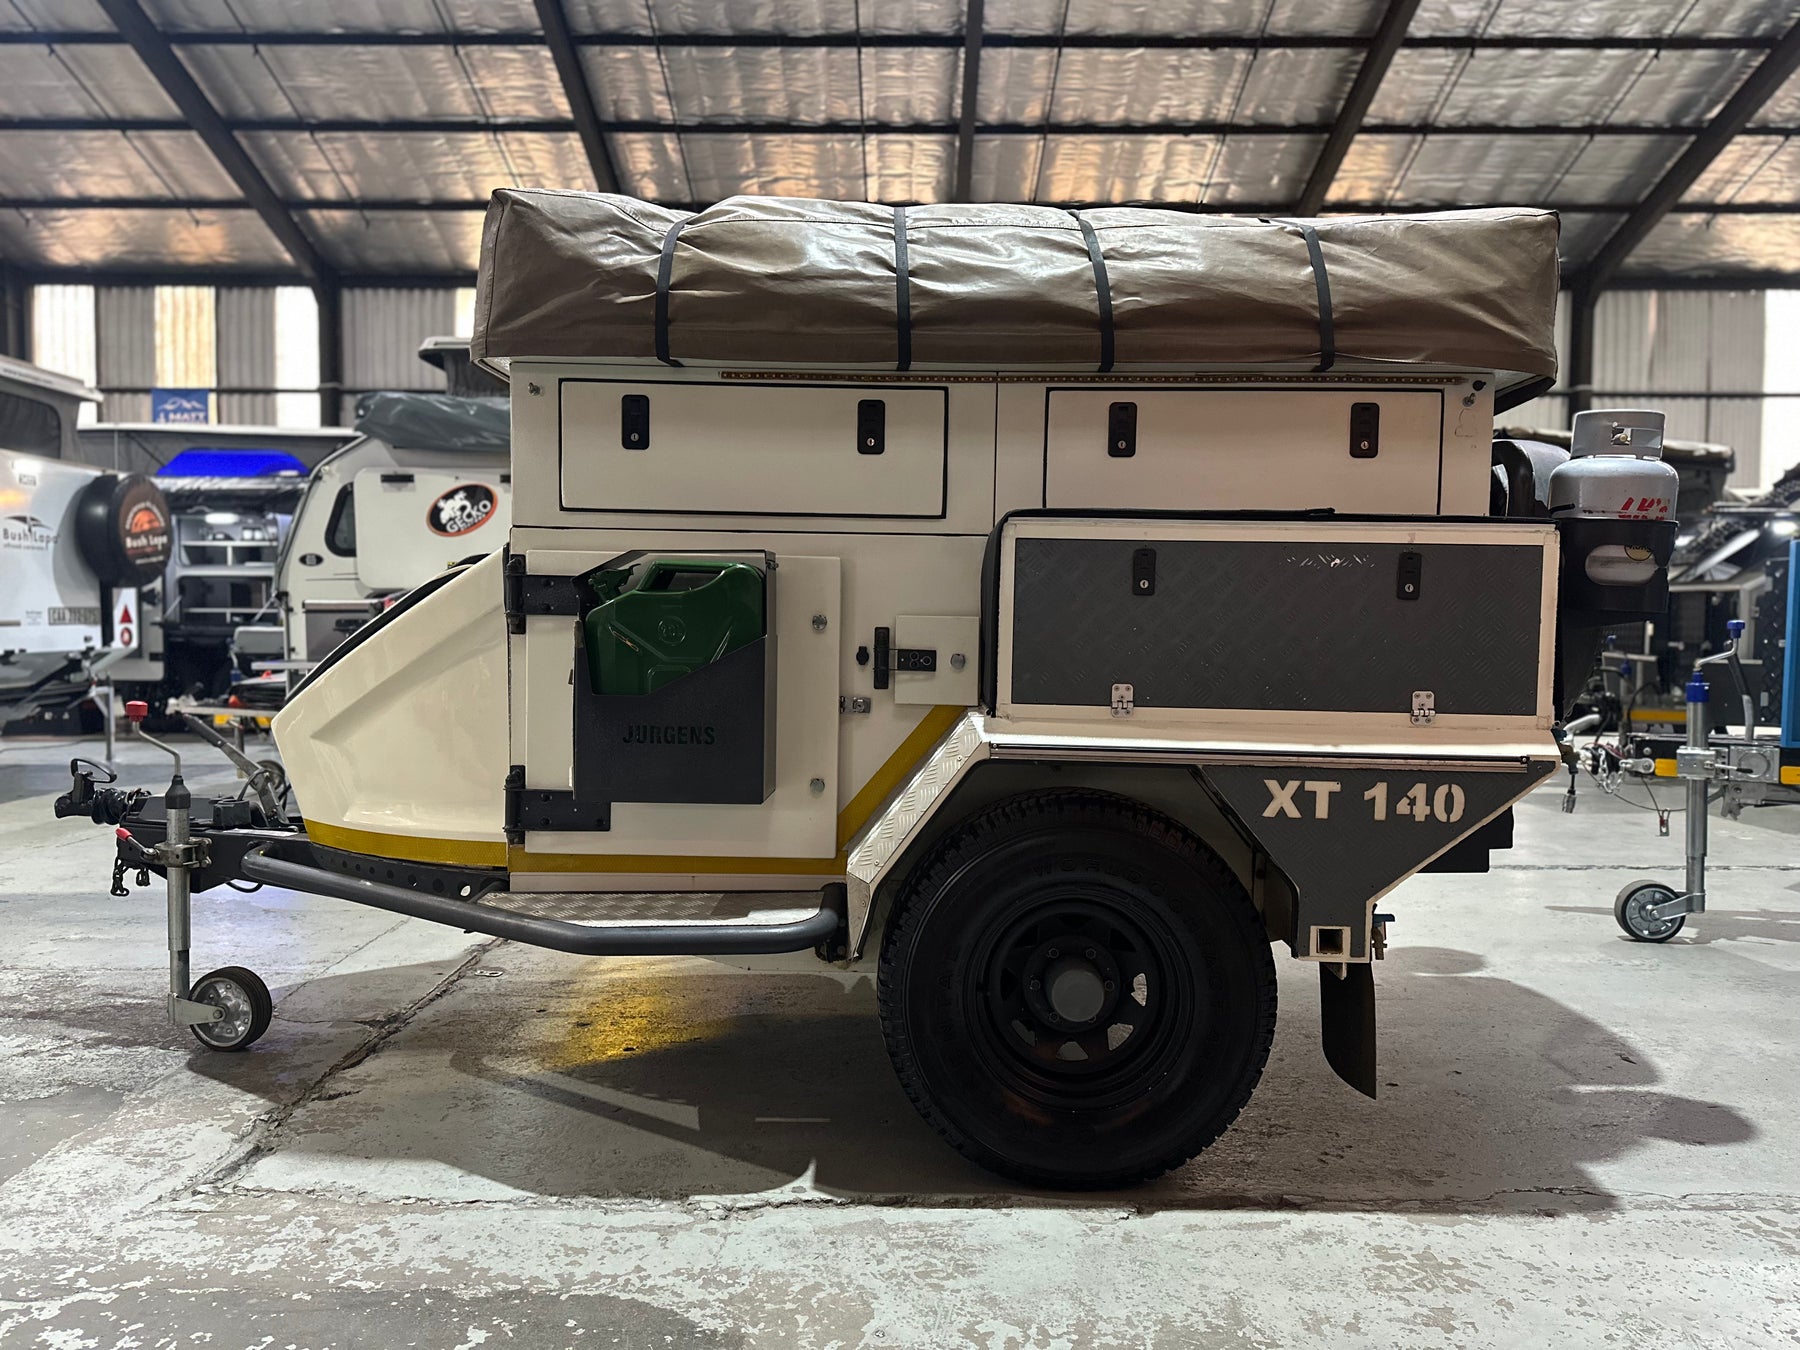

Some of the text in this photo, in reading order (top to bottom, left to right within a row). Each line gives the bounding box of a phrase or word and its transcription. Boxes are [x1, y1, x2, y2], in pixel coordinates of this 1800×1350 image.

[446, 500, 491, 532] GECKO
[3, 528, 29, 542] Bush
[33, 530, 59, 550] Lapa
[125, 533, 168, 550] Bush Lapa
[622, 724, 716, 745] JURGENS
[1261, 779, 1466, 823] XT 140
